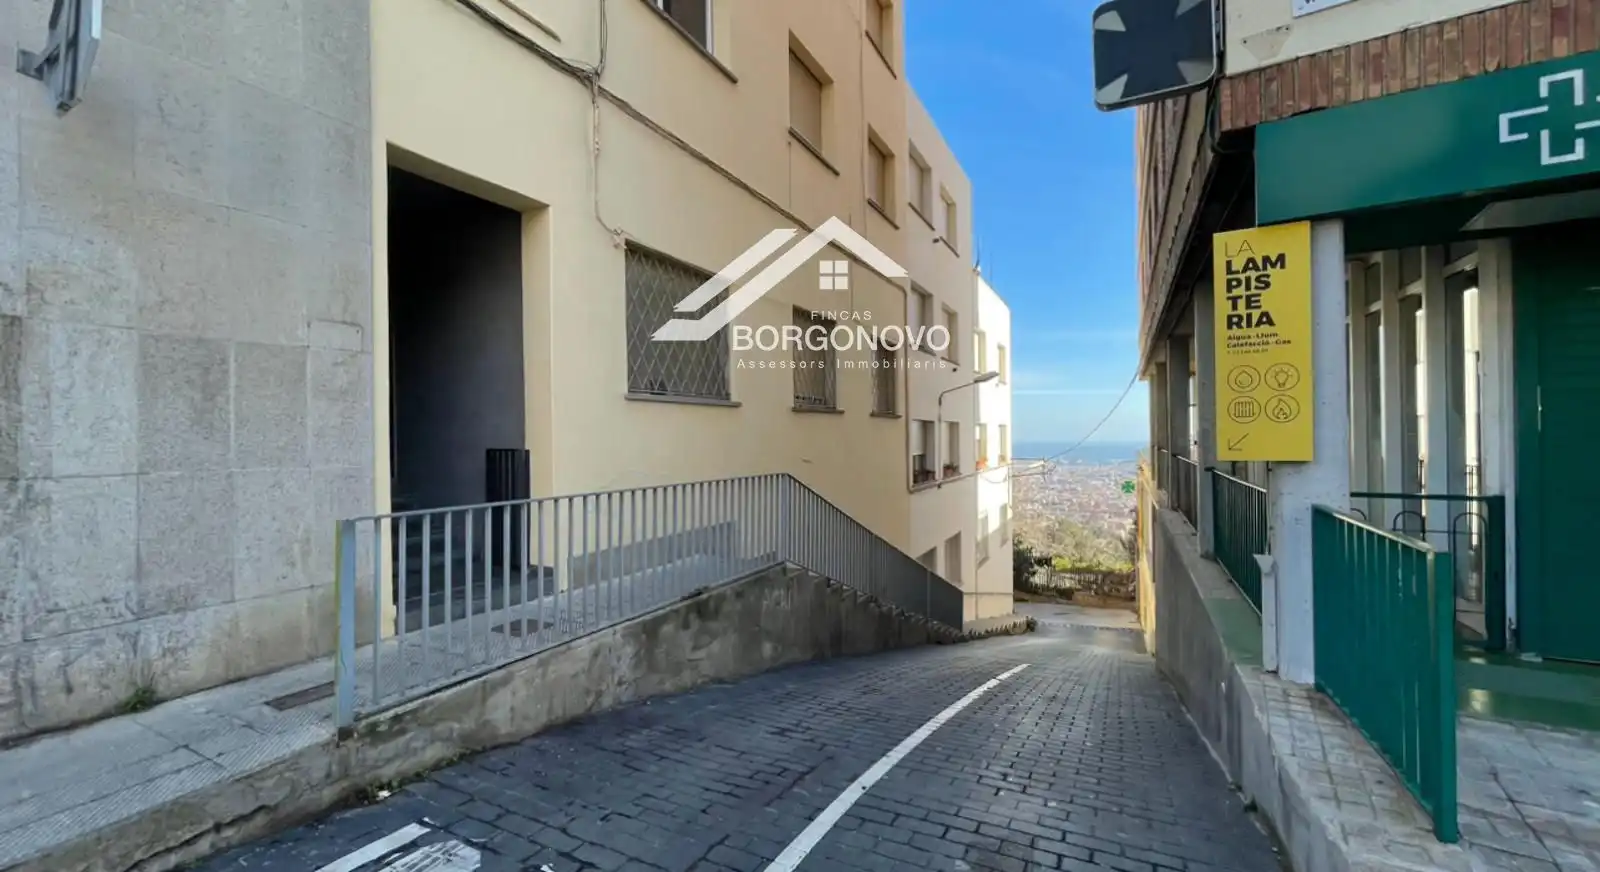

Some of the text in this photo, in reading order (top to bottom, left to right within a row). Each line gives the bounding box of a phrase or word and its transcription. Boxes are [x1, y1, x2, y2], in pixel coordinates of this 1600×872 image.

[1225, 240, 1256, 258] LA
[1226, 253, 1286, 275] LAM
[1226, 274, 1271, 293] PIS
[1226, 293, 1262, 311] TE
[1227, 311, 1276, 330] RIA
